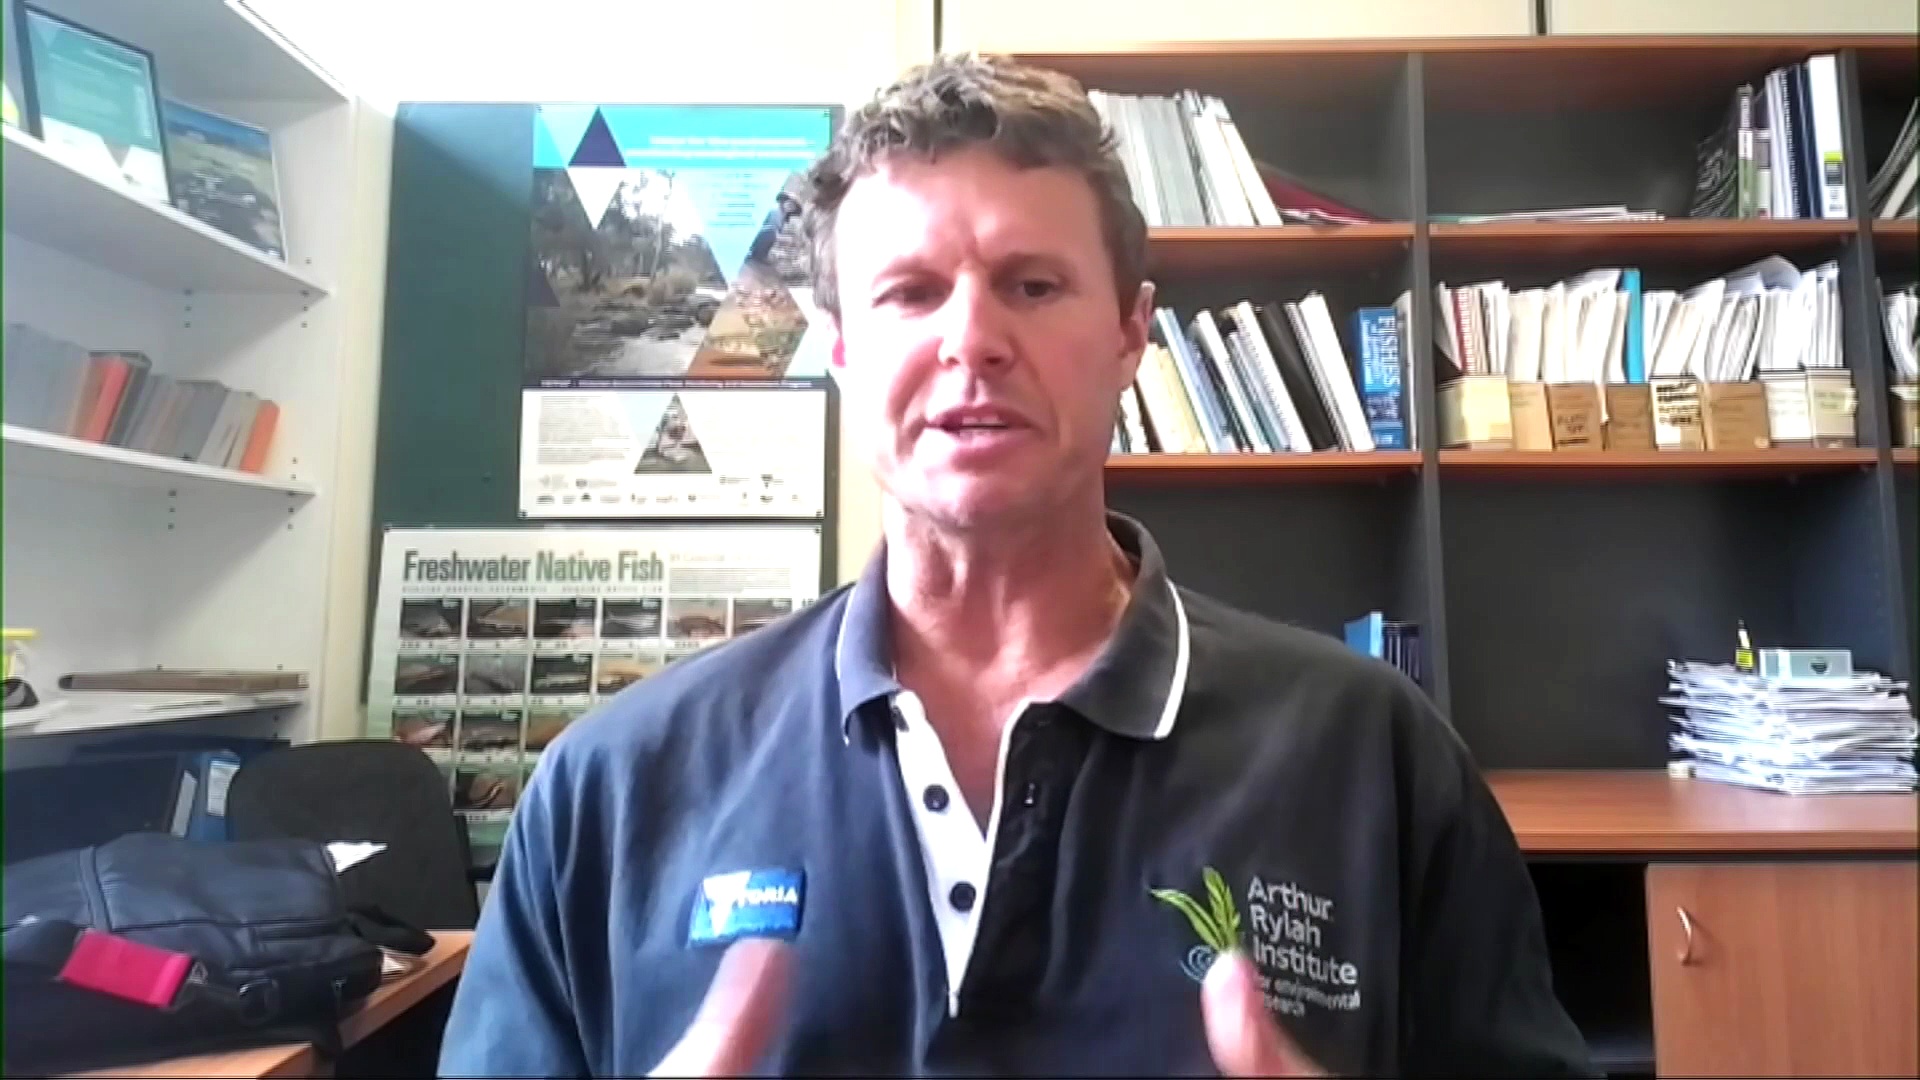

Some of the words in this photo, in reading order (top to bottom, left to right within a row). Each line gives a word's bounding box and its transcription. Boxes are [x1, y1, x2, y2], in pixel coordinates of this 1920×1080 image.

[1379, 316, 1401, 386] FISHES
[403, 549, 530, 582] Freshwater
[536, 549, 610, 582] Native
[618, 549, 664, 582] Fish
[1248, 875, 1333, 920] Arthur
[1250, 904, 1321, 948] Rylah
[1252, 936, 1358, 985] Institute
